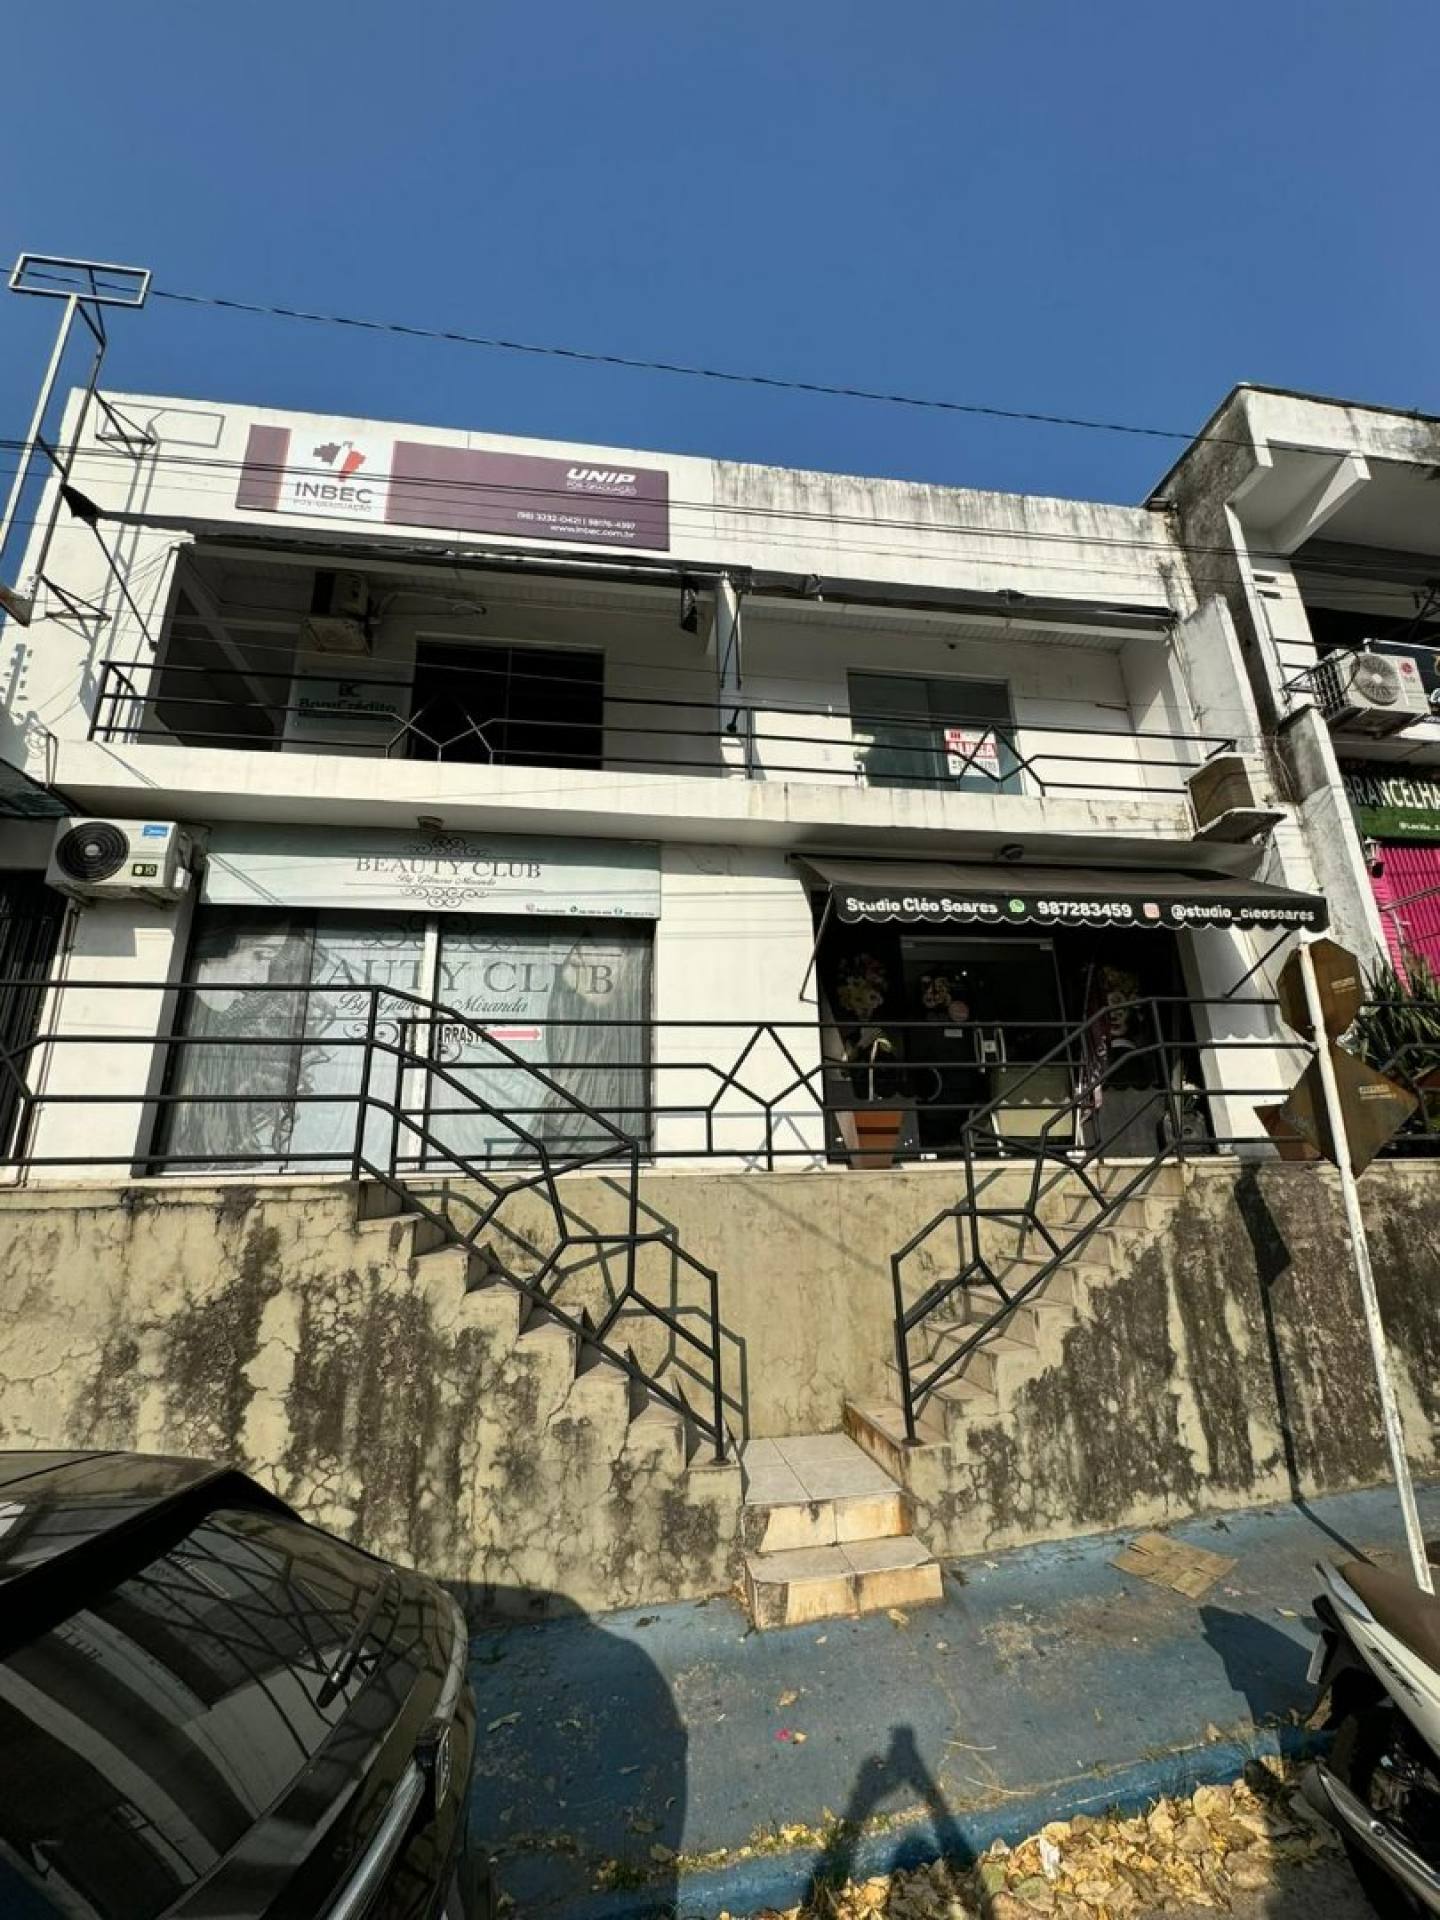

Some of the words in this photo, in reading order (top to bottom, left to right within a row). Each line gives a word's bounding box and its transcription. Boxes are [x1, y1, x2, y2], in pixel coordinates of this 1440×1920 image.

[566, 468, 637, 484] UNIP
[294, 481, 373, 504] INBEC
[356, 856, 464, 876] BEAUTY
[472, 860, 542, 879] CLUB
[846, 897, 901, 913] Studio
[902, 897, 940, 913] Cléo
[940, 898, 999, 914] Soares
[1037, 900, 1133, 919] 987283459
[337, 992, 368, 1014] By
[451, 993, 530, 1013] Miranda
